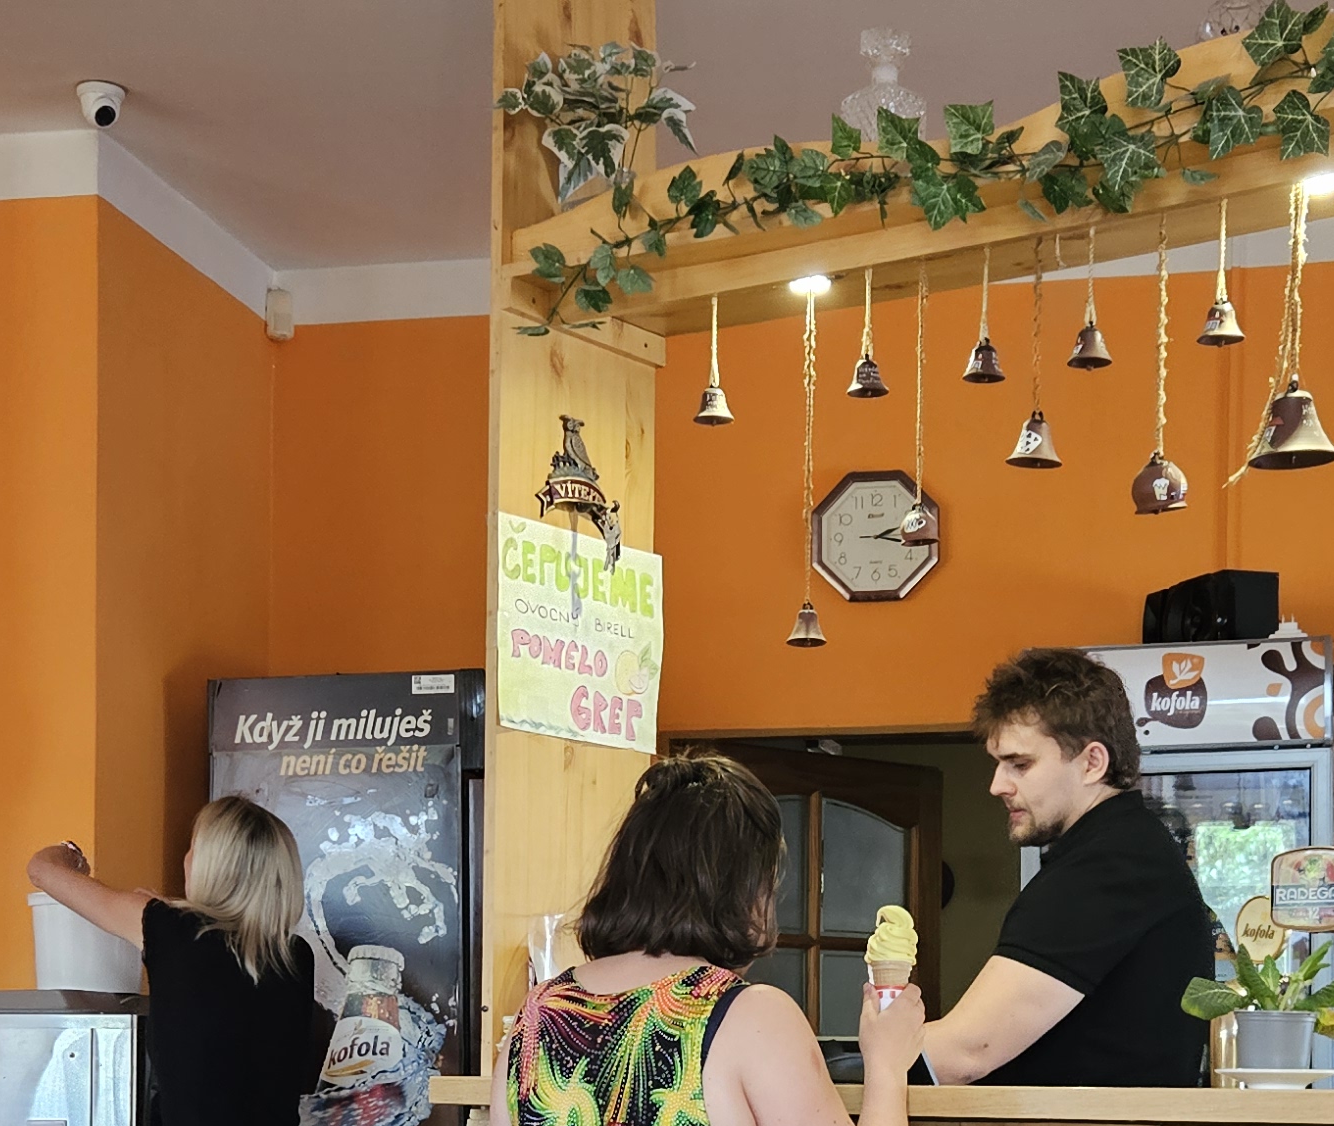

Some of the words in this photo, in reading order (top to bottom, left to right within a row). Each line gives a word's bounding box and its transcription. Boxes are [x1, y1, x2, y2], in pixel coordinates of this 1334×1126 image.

[871, 493, 883, 507] 12
[839, 513, 853, 526] 10
[834, 532, 844, 546] 9
[838, 552, 847, 565] 8
[904, 548, 913, 560] 4
[502, 519, 654, 618] ČEPUJEME
[853, 566, 862, 579] 7
[871, 568, 881, 581] 6
[888, 564, 898, 578] 5
[595, 618, 634, 639] BIRELL
[511, 628, 608, 678] POMELO
[570, 685, 643, 741] GREP
[1150, 690, 1200, 716] kofola
[234, 712, 302, 750] Když
[304, 711, 327, 749] ji
[330, 708, 432, 746] miluješ
[279, 748, 336, 776] není
[338, 752, 366, 775] co
[371, 744, 427, 773] řešit
[1241, 922, 1275, 942] kofola
[327, 1035, 390, 1070] kofola
